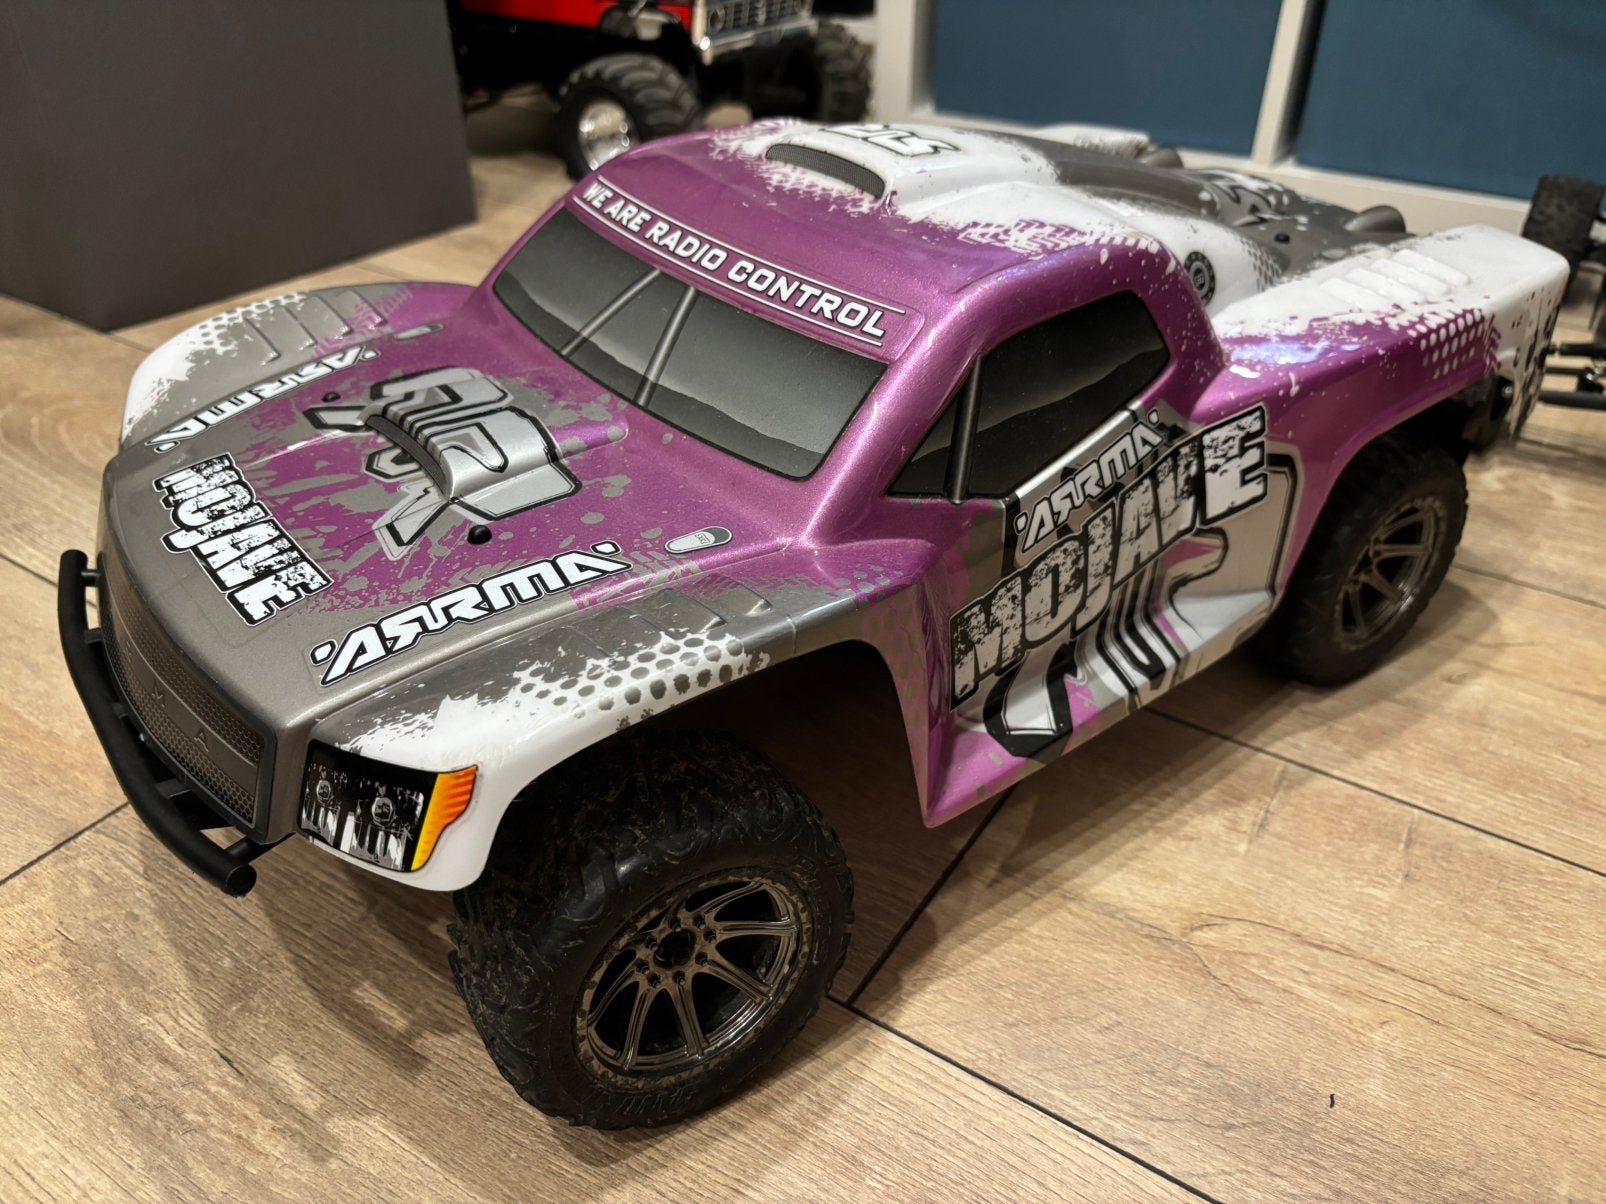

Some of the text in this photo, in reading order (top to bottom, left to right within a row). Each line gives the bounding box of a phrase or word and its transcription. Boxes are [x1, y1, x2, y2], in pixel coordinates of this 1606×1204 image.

[582, 182, 886, 337] WE ARE RADIO CONTROL
[153, 452, 334, 626] MOJAVE
[950, 403, 1268, 710] MOJAVE
